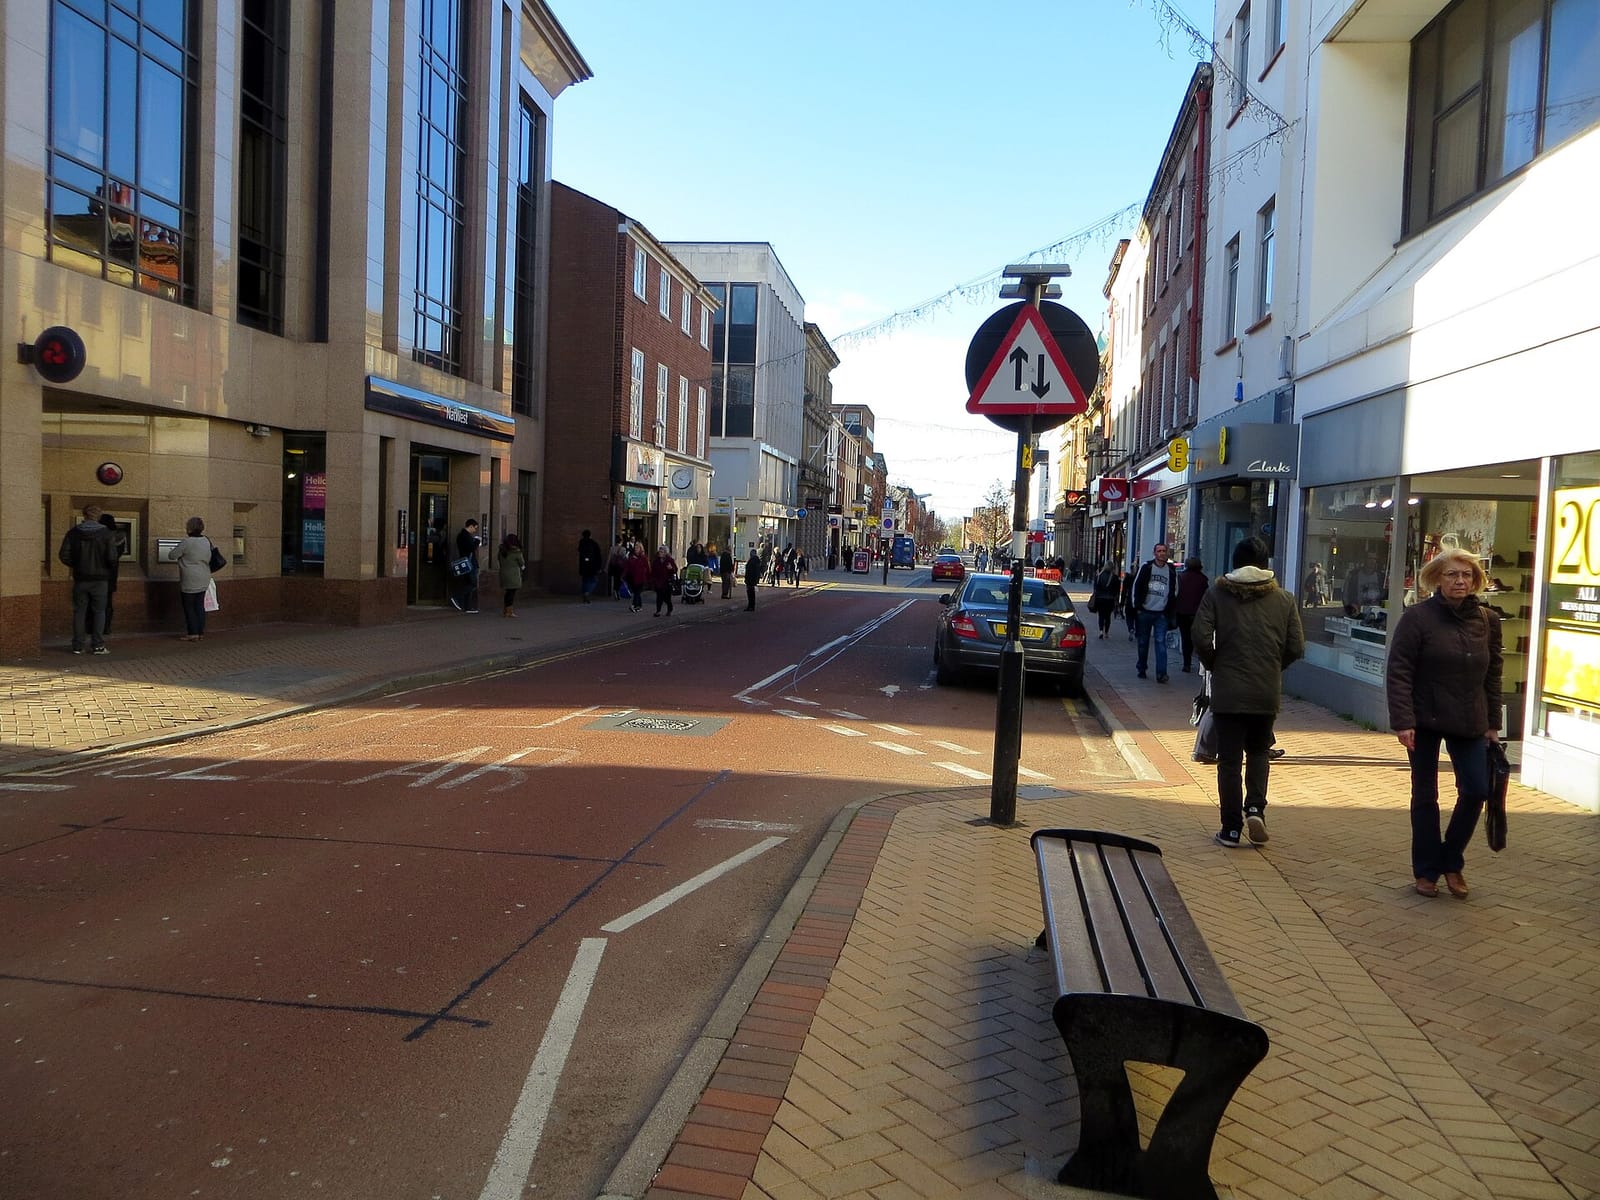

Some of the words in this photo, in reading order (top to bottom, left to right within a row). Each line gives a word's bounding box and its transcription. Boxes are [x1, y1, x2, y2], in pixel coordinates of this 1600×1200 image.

[446, 406, 468, 424] NatWest
[1246, 460, 1291, 473] Clarks
[1576, 587, 1598, 601] ALL
